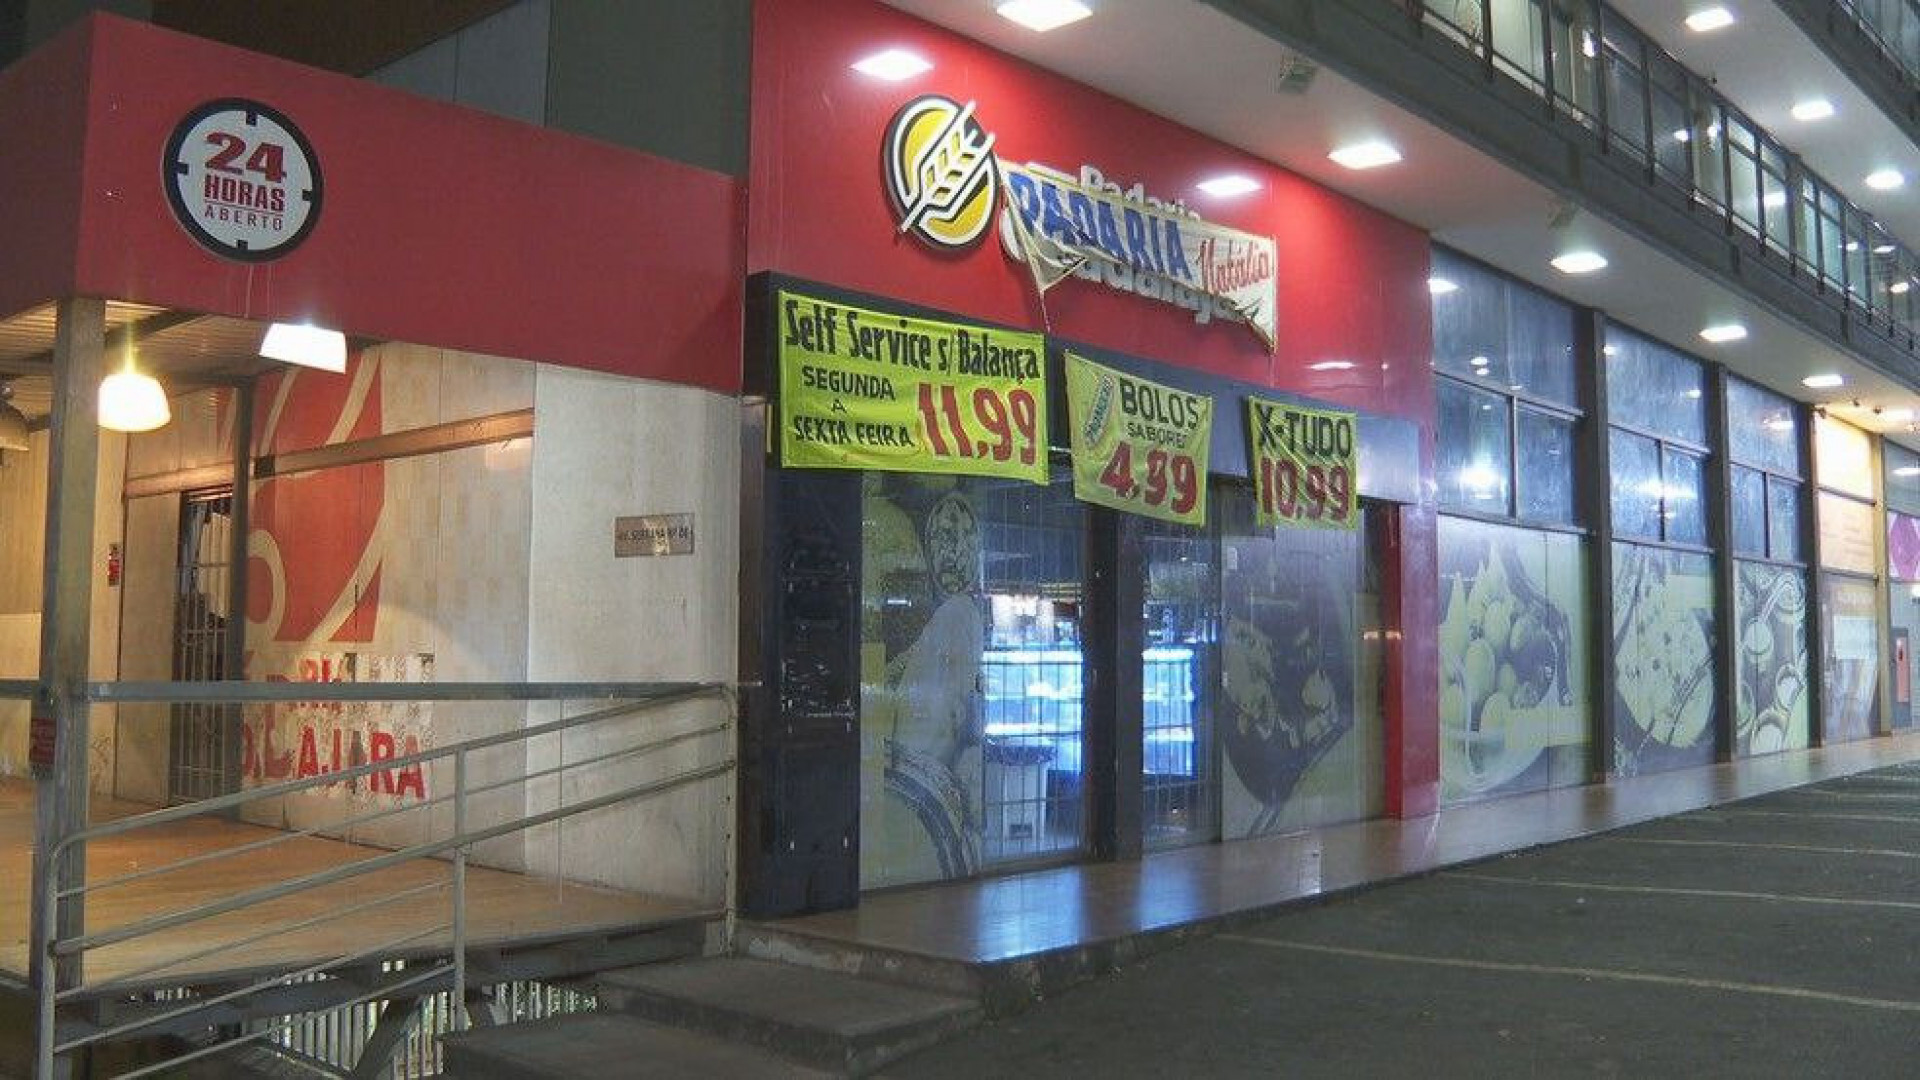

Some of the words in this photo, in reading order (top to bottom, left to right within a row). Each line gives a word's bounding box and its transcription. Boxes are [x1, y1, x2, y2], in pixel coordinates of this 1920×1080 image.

[205, 131, 288, 183] 24
[204, 174, 286, 212] HORAS
[204, 204, 283, 232] ABERTO
[1008, 171, 1193, 281] PADARIA
[785, 300, 837, 355] Self
[847, 311, 932, 371] Service
[802, 366, 896, 401] SEGUNDA
[831, 400, 848, 413] A
[1119, 377, 1199, 430] BOLOS
[793, 416, 851, 446] SEXTA
[856, 422, 915, 447] FEIRA
[918, 383, 1037, 466] 11,99
[1254, 402, 1351, 459] X-TUDO
[1100, 441, 1197, 514] 4,99
